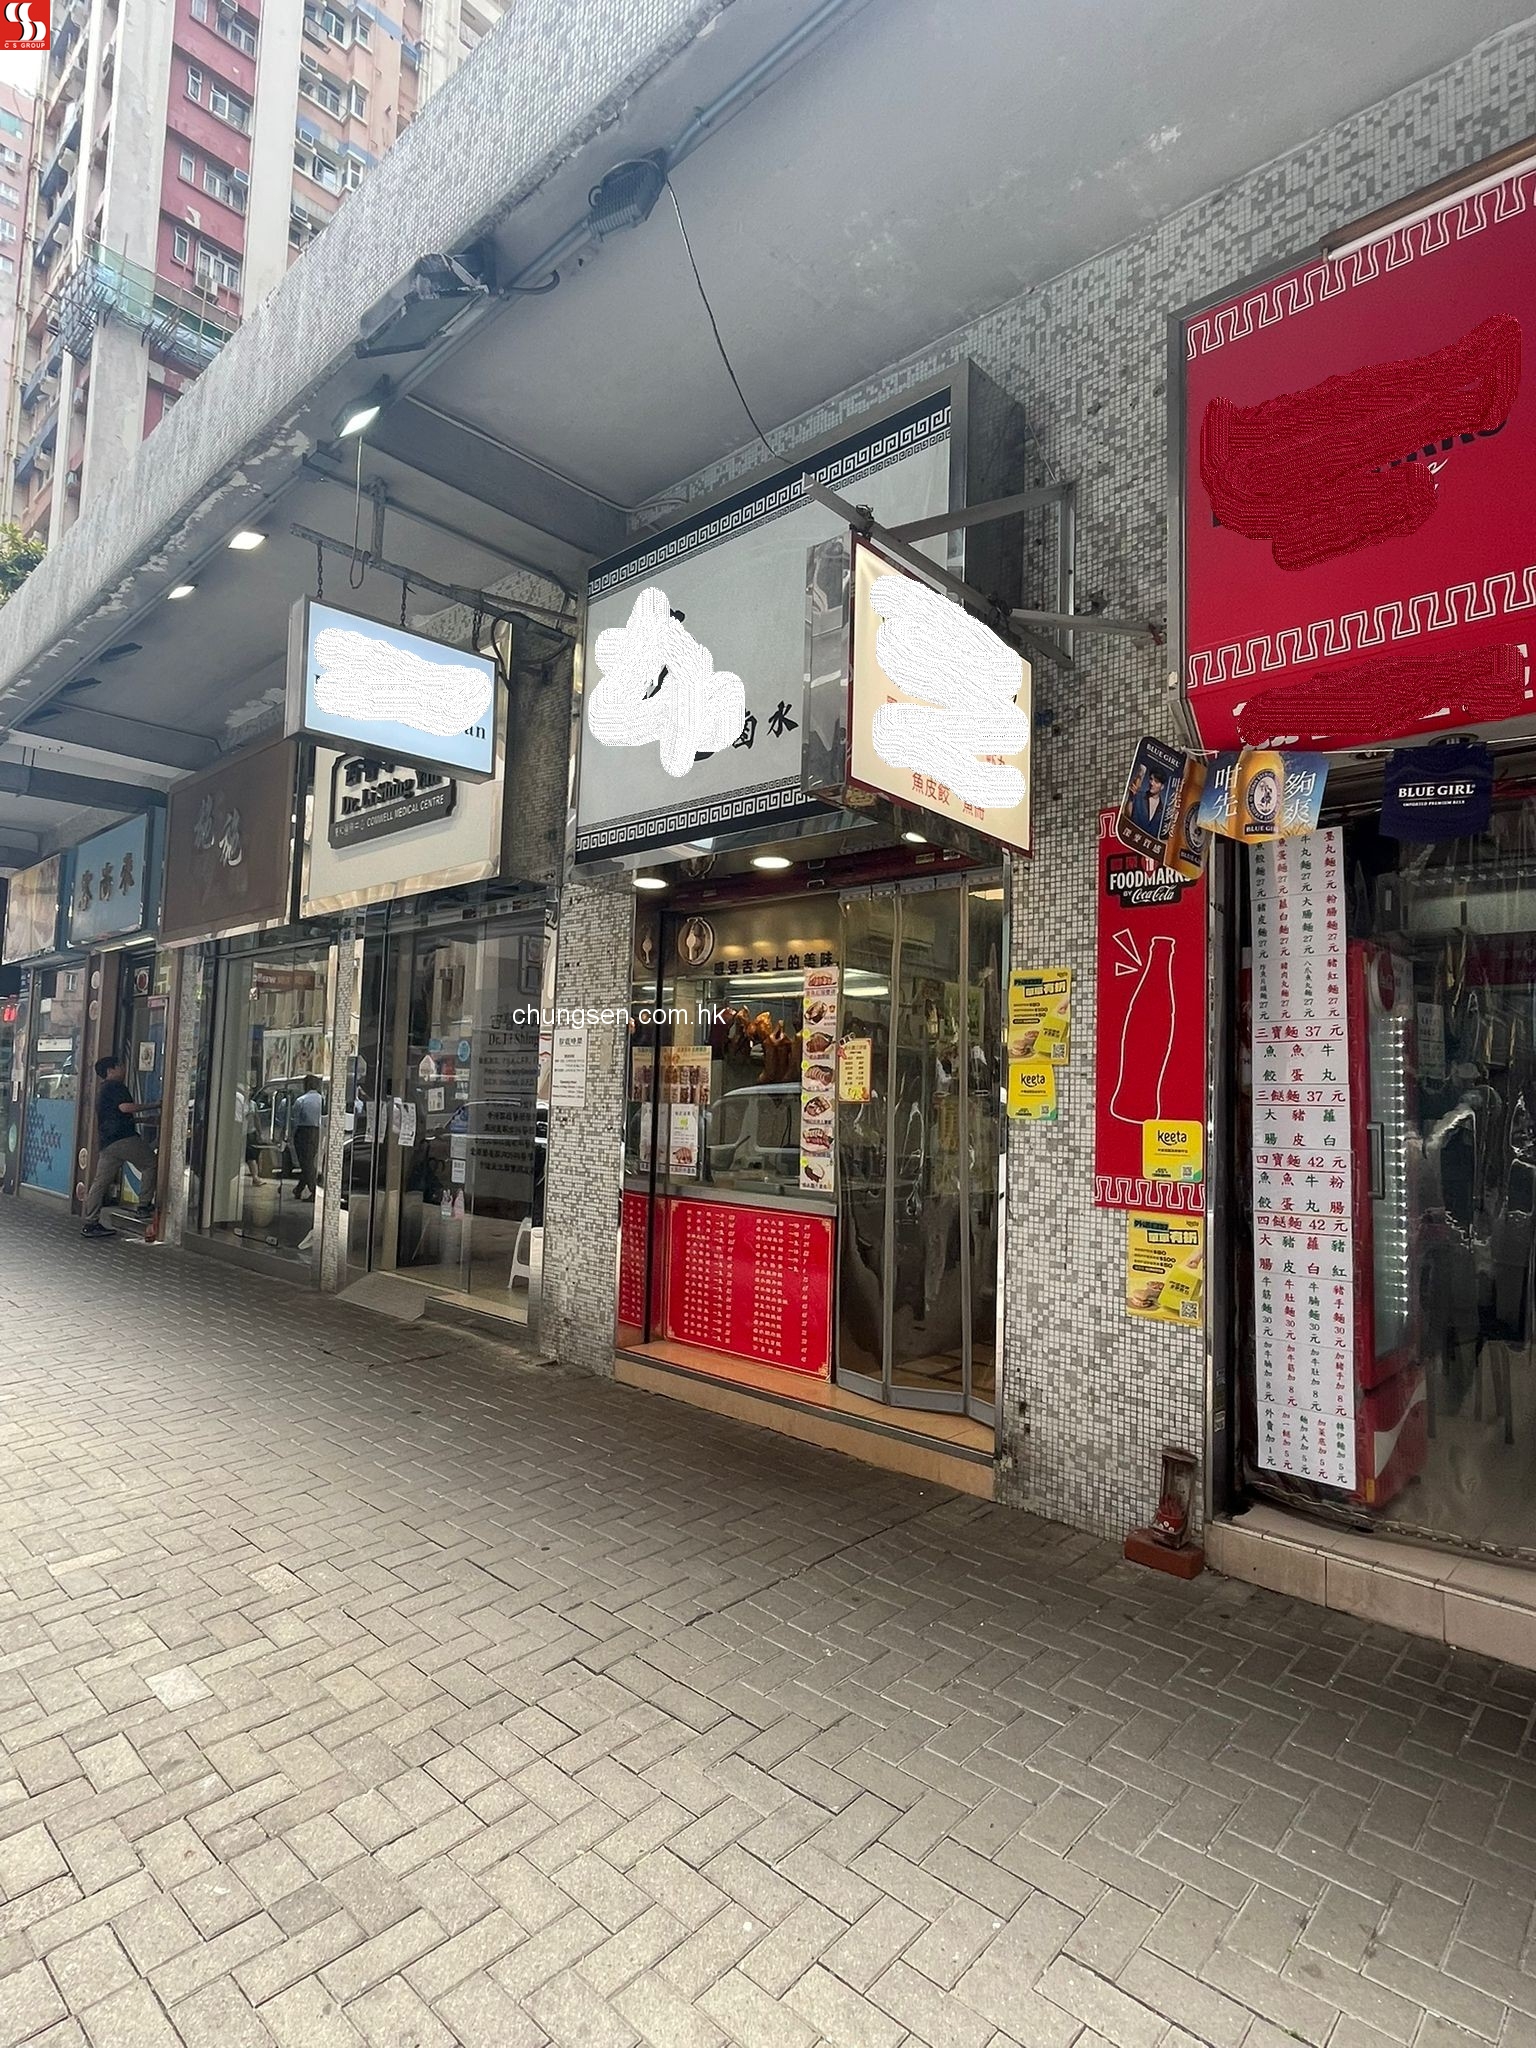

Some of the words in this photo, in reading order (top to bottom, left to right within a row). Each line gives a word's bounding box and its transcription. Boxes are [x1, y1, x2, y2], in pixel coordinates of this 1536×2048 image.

[1211, 762, 1242, 821] 咁先
[1398, 786, 1435, 798] BLUE
[1436, 783, 1475, 796] GIRL
[394, 803, 419, 819] MEDICAL
[420, 794, 445, 811] CENTRE
[1283, 770, 1318, 828] 夠爽
[1109, 867, 1192, 891] FOODMARK
[1123, 889, 1133, 897] BY
[1305, 1025, 1322, 1037] 37
[1329, 1023, 1345, 1037] 元
[1020, 1072, 1046, 1087] keeta
[1306, 1090, 1324, 1103] 37
[1331, 1089, 1347, 1103] 元
[1157, 1129, 1188, 1146] keeta
[1307, 1156, 1325, 1168] 42
[1332, 1156, 1348, 1169] 元
[1308, 1219, 1326, 1231] 42
[1333, 1219, 1348, 1232] 元
